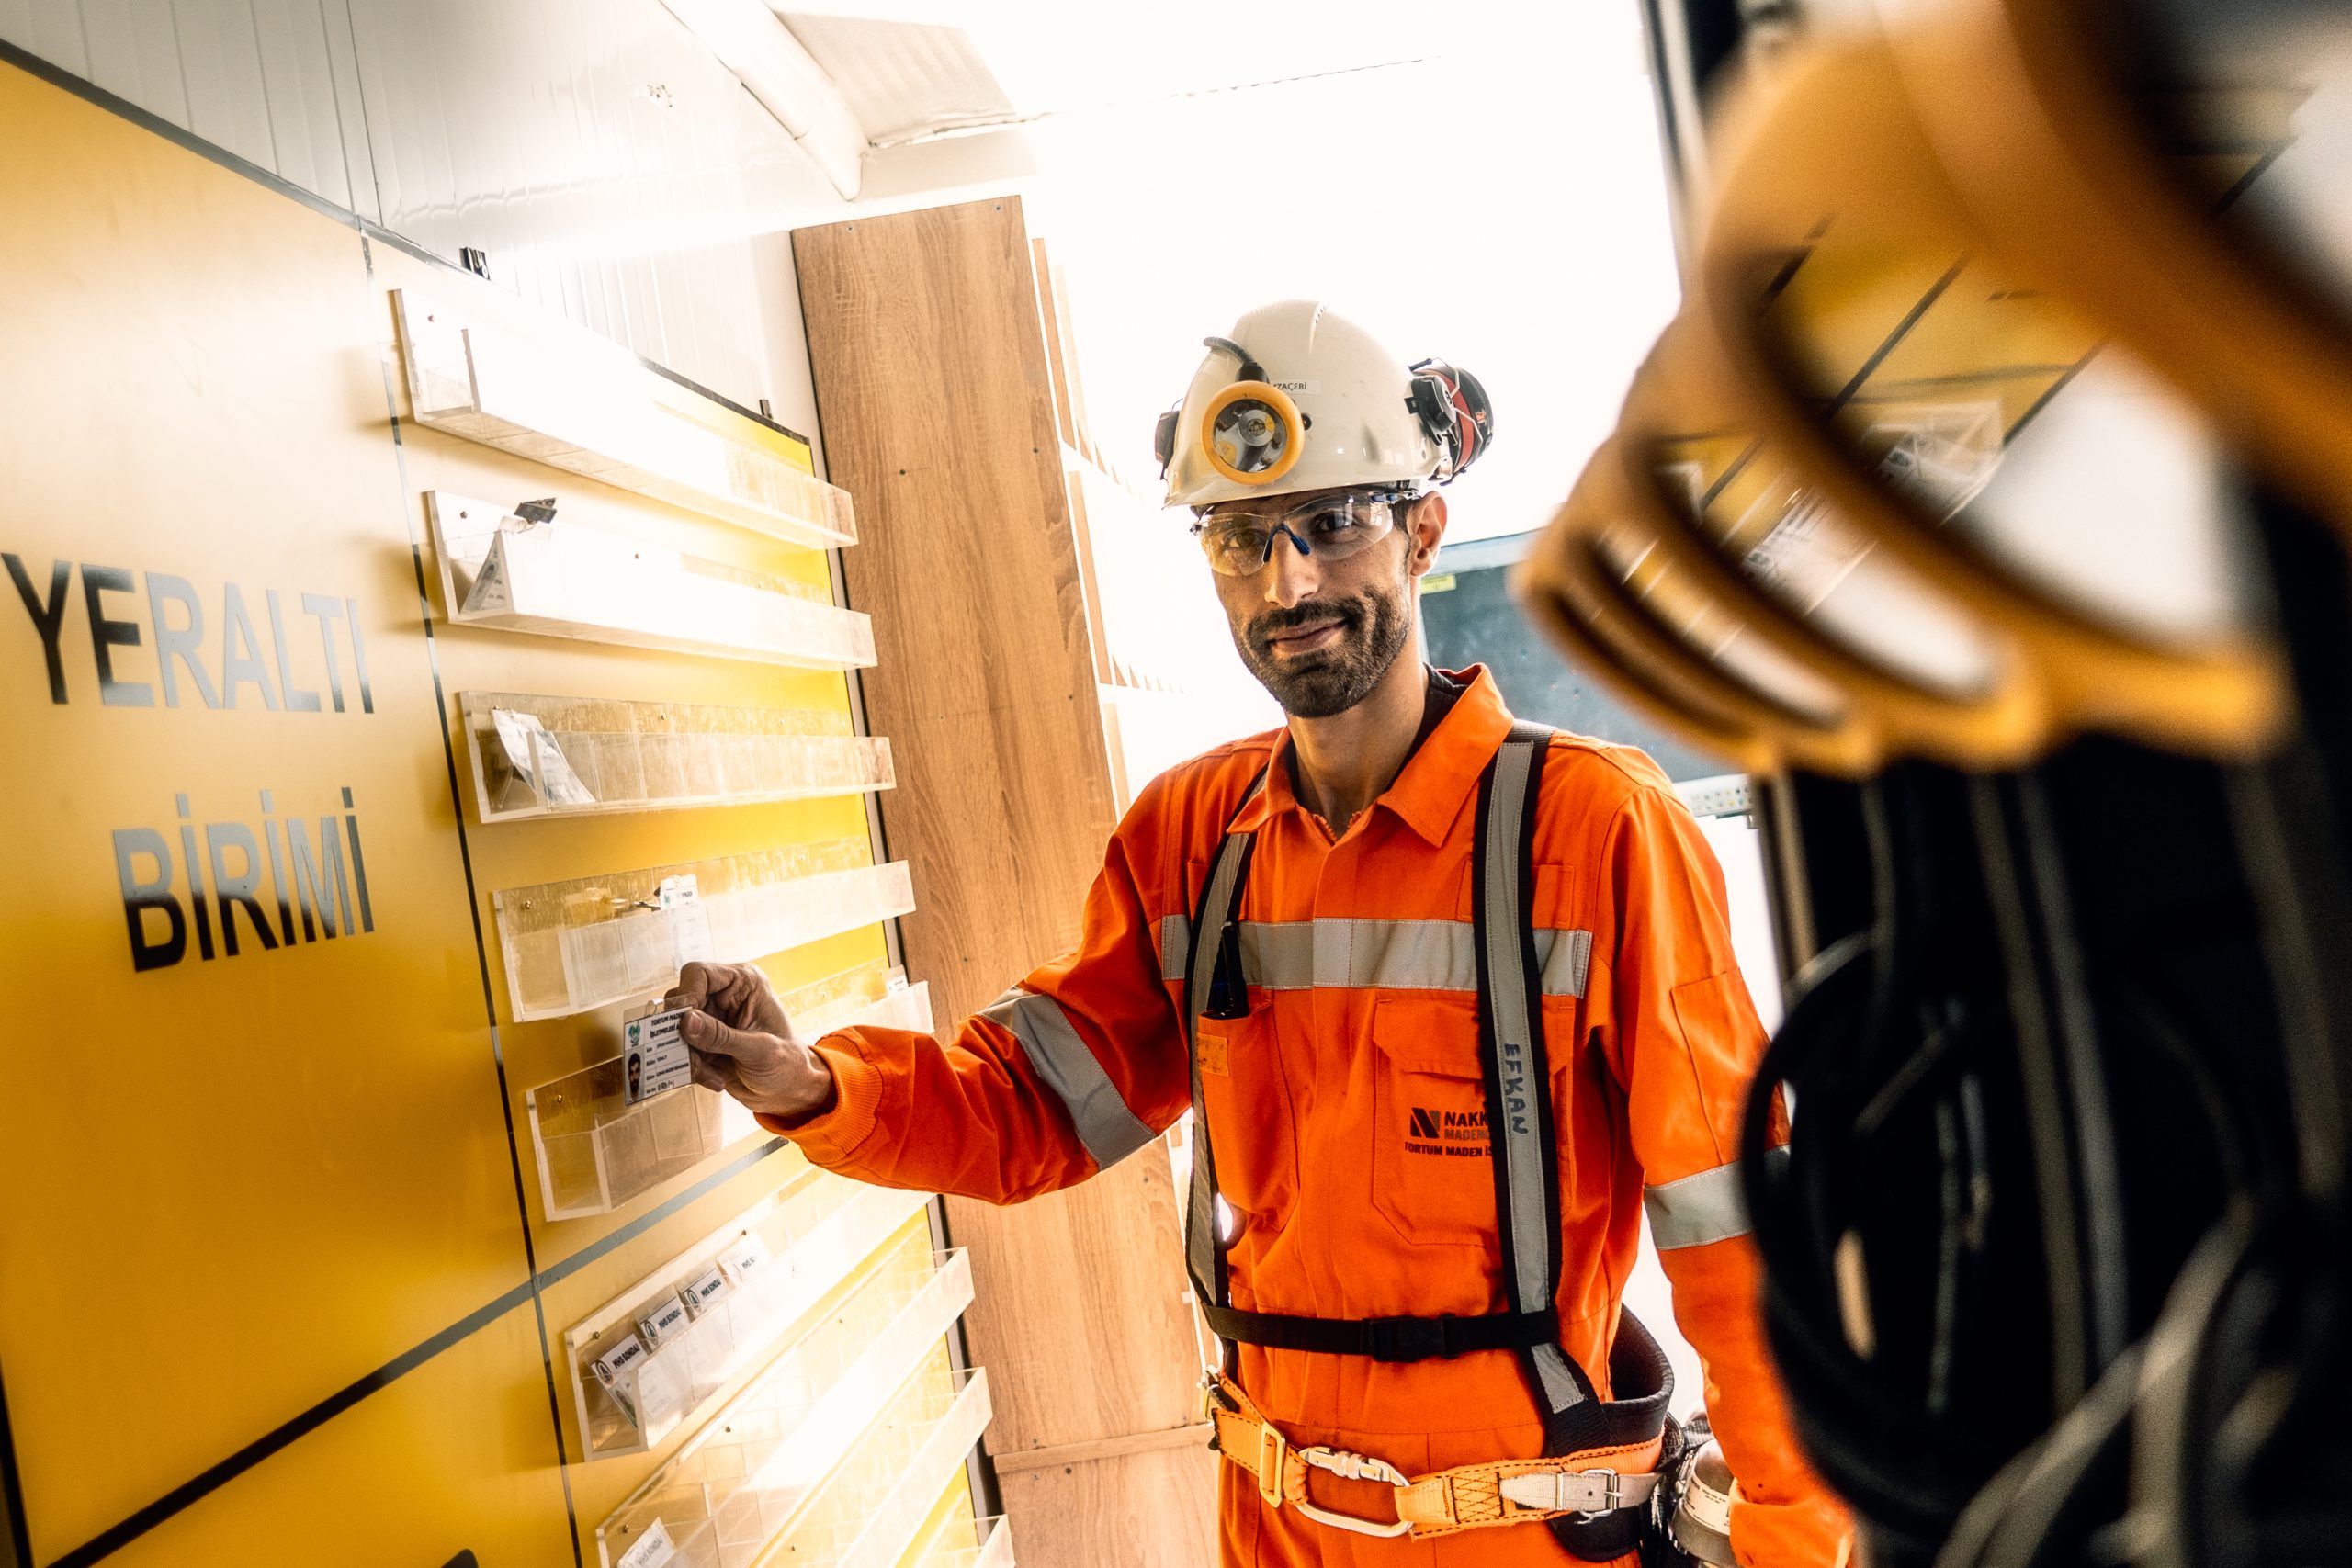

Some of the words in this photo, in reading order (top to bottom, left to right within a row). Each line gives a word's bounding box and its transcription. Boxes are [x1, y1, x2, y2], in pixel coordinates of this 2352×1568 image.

[1273, 382, 1306, 391] ZAÇEBİ
[2, 553, 375, 714] YERALTI
[112, 787, 375, 973] BİRİMİ
[1504, 1043, 1529, 1134] EFKAN
[1404, 1141, 1443, 1156] TORTUM
[1445, 1145, 1483, 1157] MADEN
